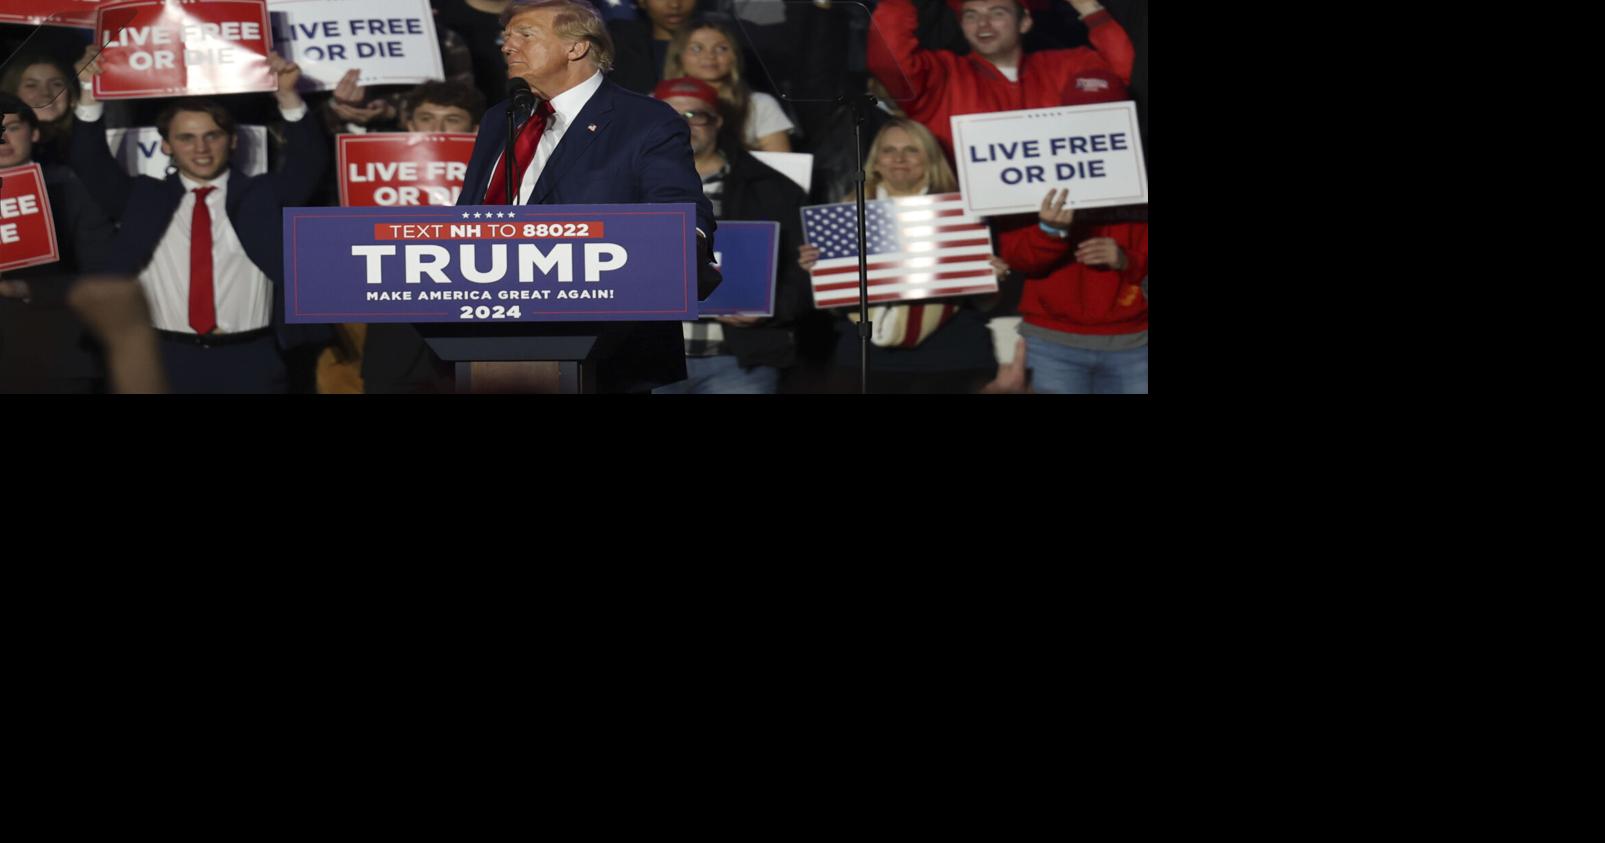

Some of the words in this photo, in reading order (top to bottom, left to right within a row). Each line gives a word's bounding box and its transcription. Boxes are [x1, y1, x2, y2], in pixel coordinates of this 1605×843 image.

[103, 26, 172, 48] LIVE
[181, 21, 261, 43] FREE
[349, 18, 423, 36] FREE
[129, 51, 175, 71] OR
[184, 48, 235, 66] DIE
[304, 44, 347, 61] OR
[356, 41, 405, 58] DIE
[970, 140, 1041, 163] LIVE
[1049, 132, 1128, 156] FREE
[349, 161, 418, 182] LIVE
[427, 161, 468, 181] FR
[1000, 165, 1045, 185] OR
[1056, 160, 1106, 181] DIE
[0, 194, 39, 219] EE
[373, 186, 420, 205] OR
[427, 186, 463, 206] DI
[389, 224, 443, 238] TEXT
[450, 224, 481, 238] NH
[488, 224, 516, 238] TO
[523, 223, 589, 237] 88022
[352, 243, 628, 284] TRUMP
[367, 291, 412, 301] MAKE
[418, 290, 492, 300] AMERICA
[498, 290, 551, 299] GREAT
[557, 289, 614, 299] AGAIN!
[460, 305, 521, 319] 2024
